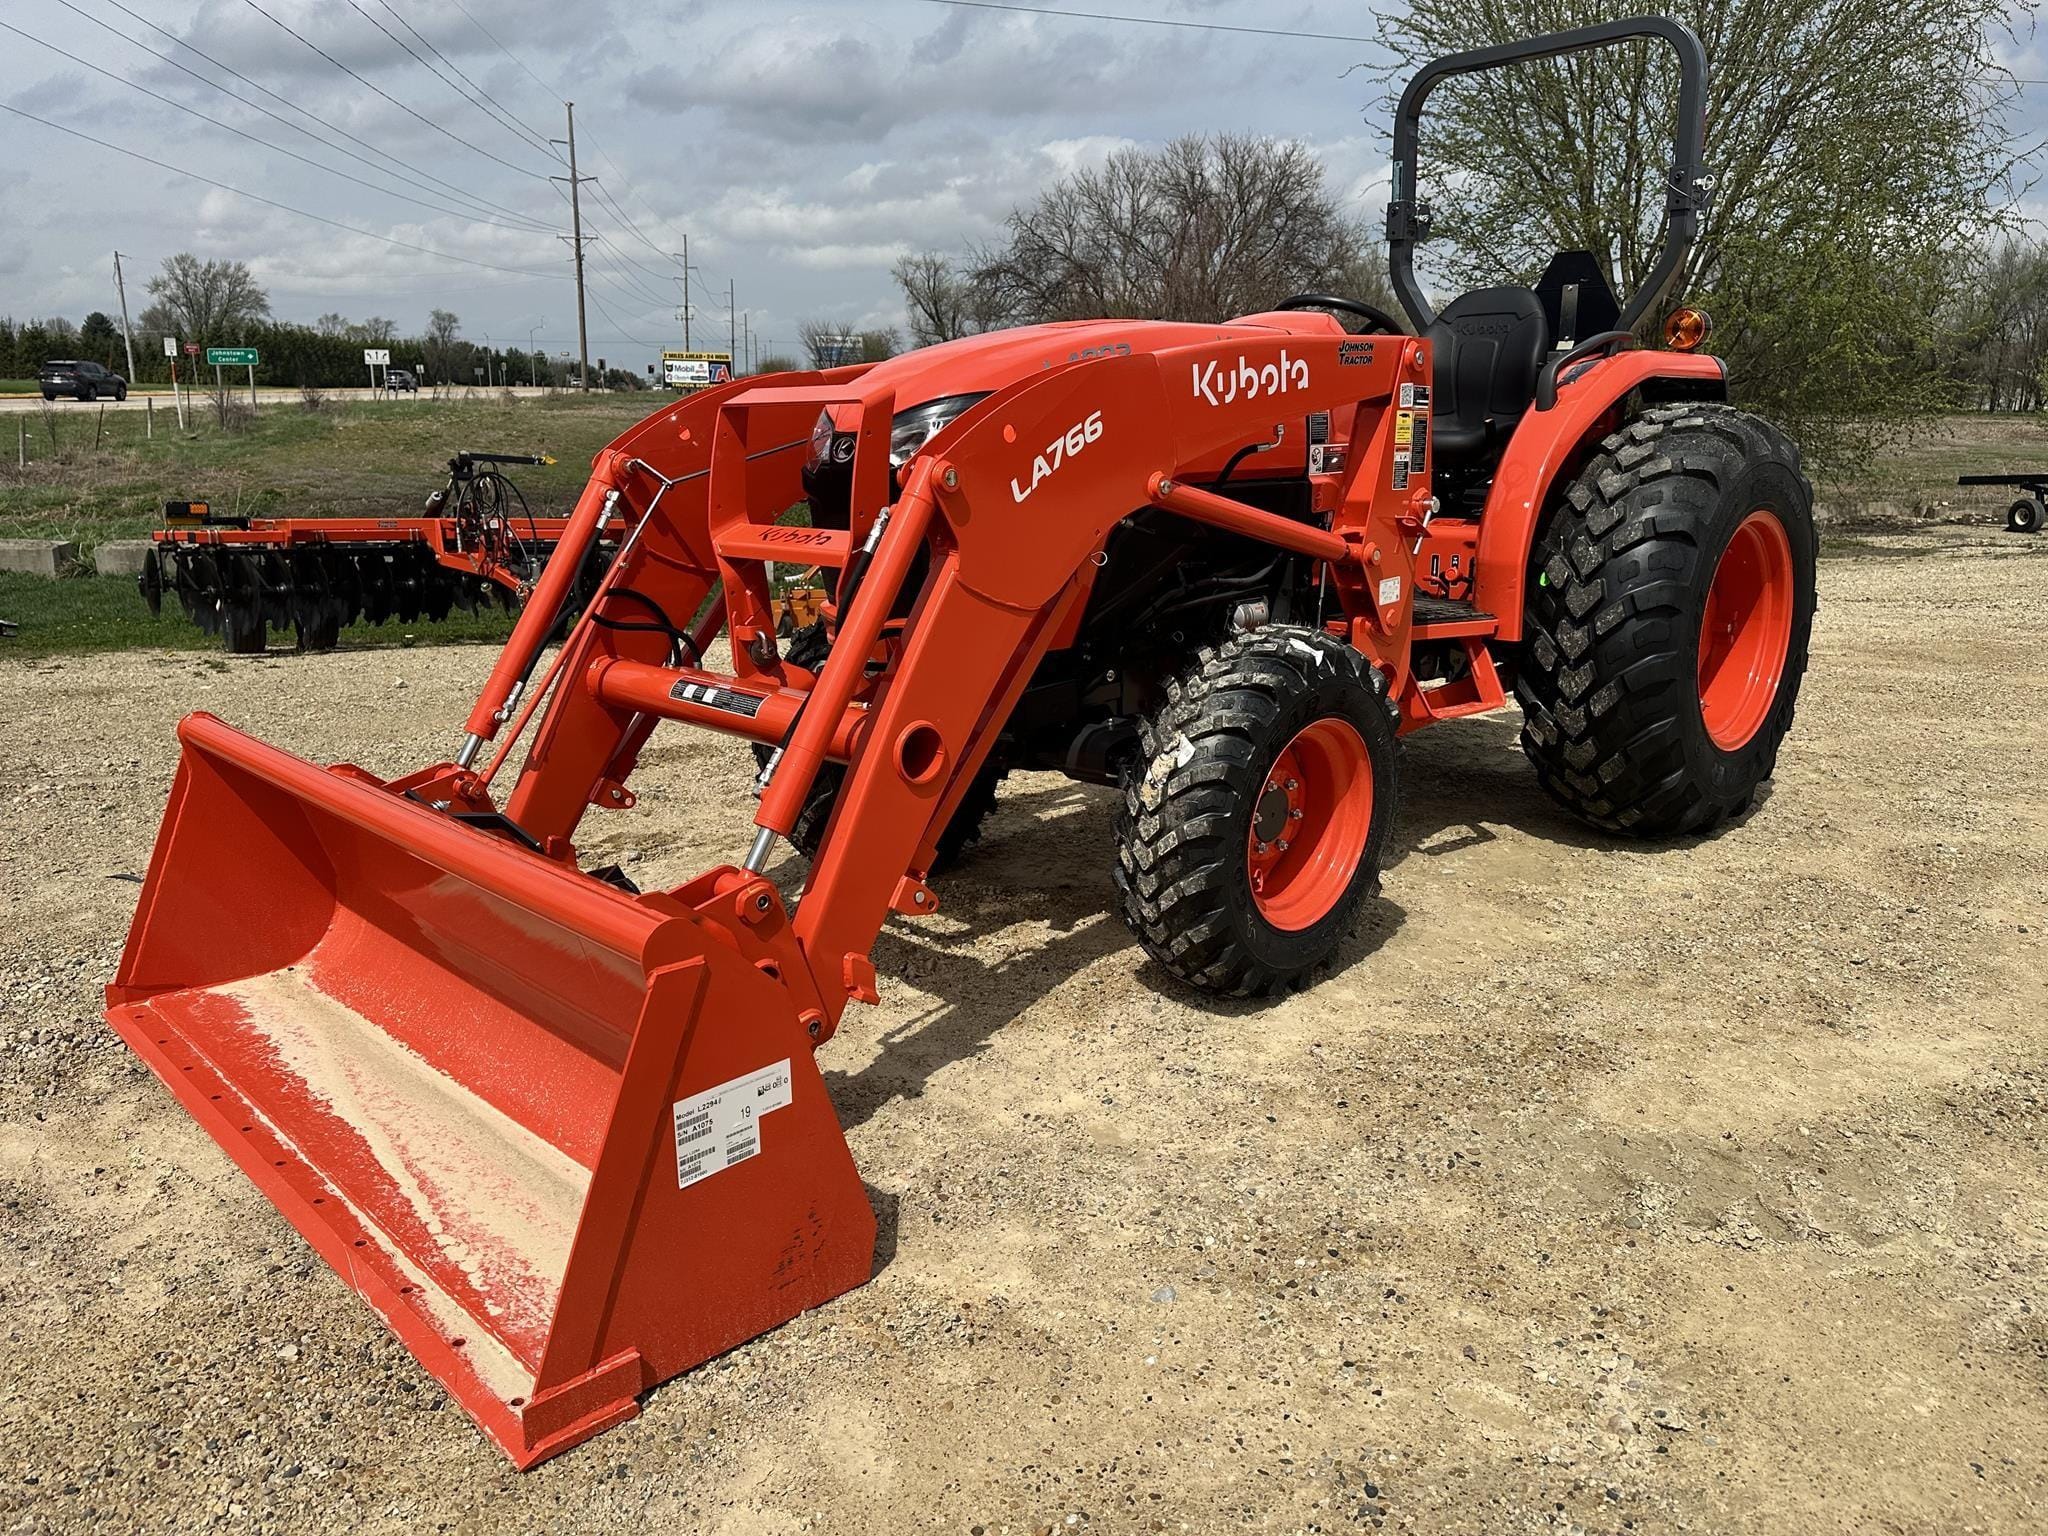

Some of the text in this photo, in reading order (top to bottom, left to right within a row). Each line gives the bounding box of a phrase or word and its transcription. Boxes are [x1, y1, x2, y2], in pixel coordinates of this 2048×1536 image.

[1339, 339, 1375, 352] JOHNSON
[1339, 353, 1374, 365] TRACTOR
[674, 364, 695, 373] Mobil
[710, 364, 731, 383] TA
[1192, 349, 1309, 406] Kubota
[1010, 409, 1103, 503] LA766
[759, 527, 832, 546] Kubota
[676, 1109, 695, 1121] Model
[740, 1105, 751, 1119] 19
